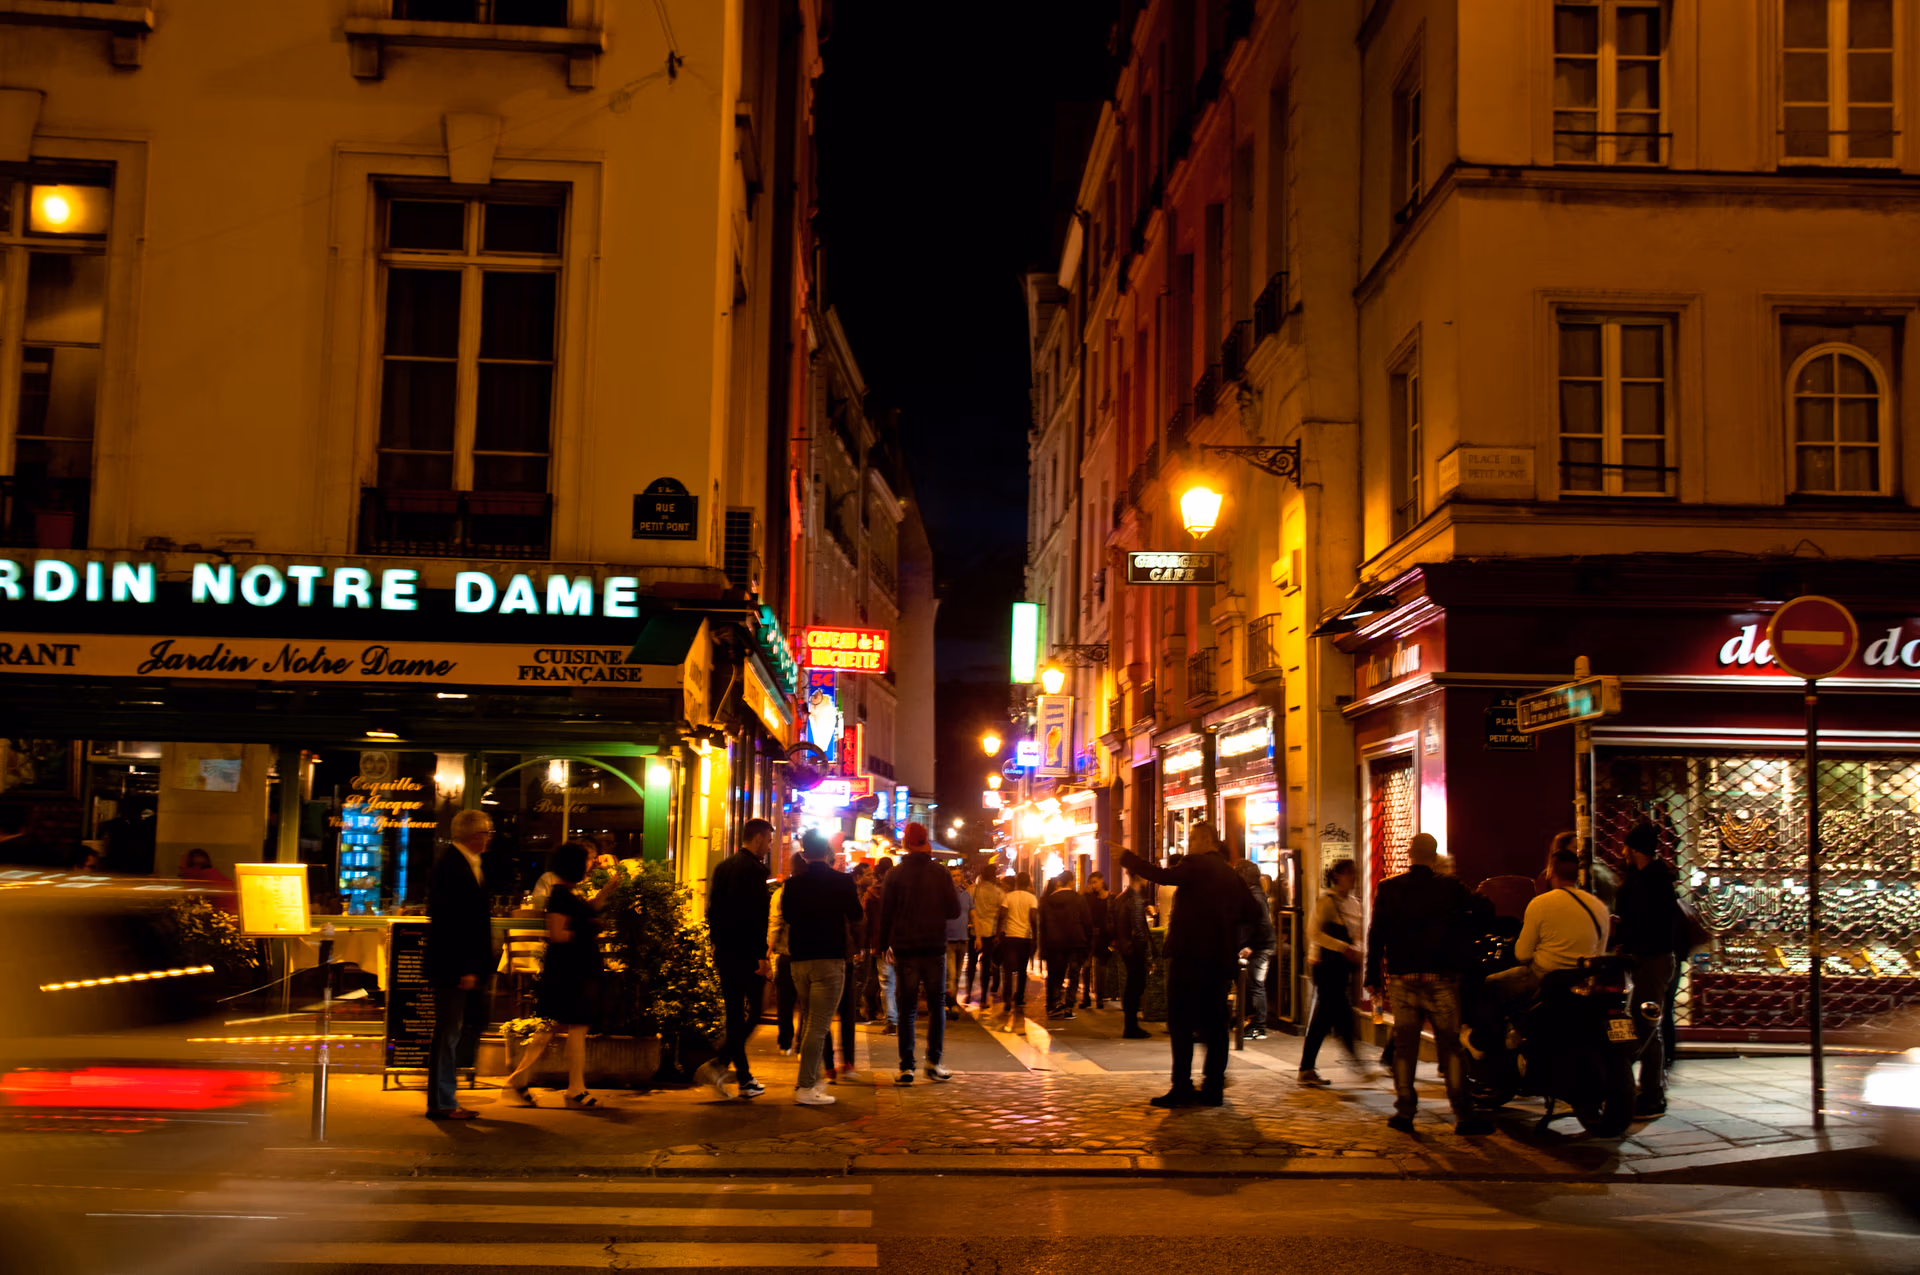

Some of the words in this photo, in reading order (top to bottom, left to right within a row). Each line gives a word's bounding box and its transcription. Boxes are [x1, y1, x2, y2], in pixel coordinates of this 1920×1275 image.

[655, 502, 676, 512] RUE
[640, 521, 664, 531] PETIT
[666, 522, 690, 532] PONT
[1134, 555, 1210, 569] GEORGES
[192, 563, 420, 611] NOTRE
[455, 571, 640, 618] DAME
[807, 630, 857, 649] CAVEAU
[858, 634, 873, 650] de
[873, 634, 885, 650] la
[0, 641, 81, 666] RANT
[137, 639, 258, 675] Jardin
[262, 643, 354, 674] Notre
[360, 644, 458, 676] Dame
[533, 648, 622, 665] CUISINE
[811, 649, 881, 669] HUCHETTE
[517, 665, 642, 684] FRANÇAISE
[1495, 717, 1518, 726] PLAC
[1489, 734, 1508, 743] PETIT
[1510, 735, 1529, 743] PONT
[349, 775, 424, 796] Coquilles
[361, 794, 424, 815] Jacque
